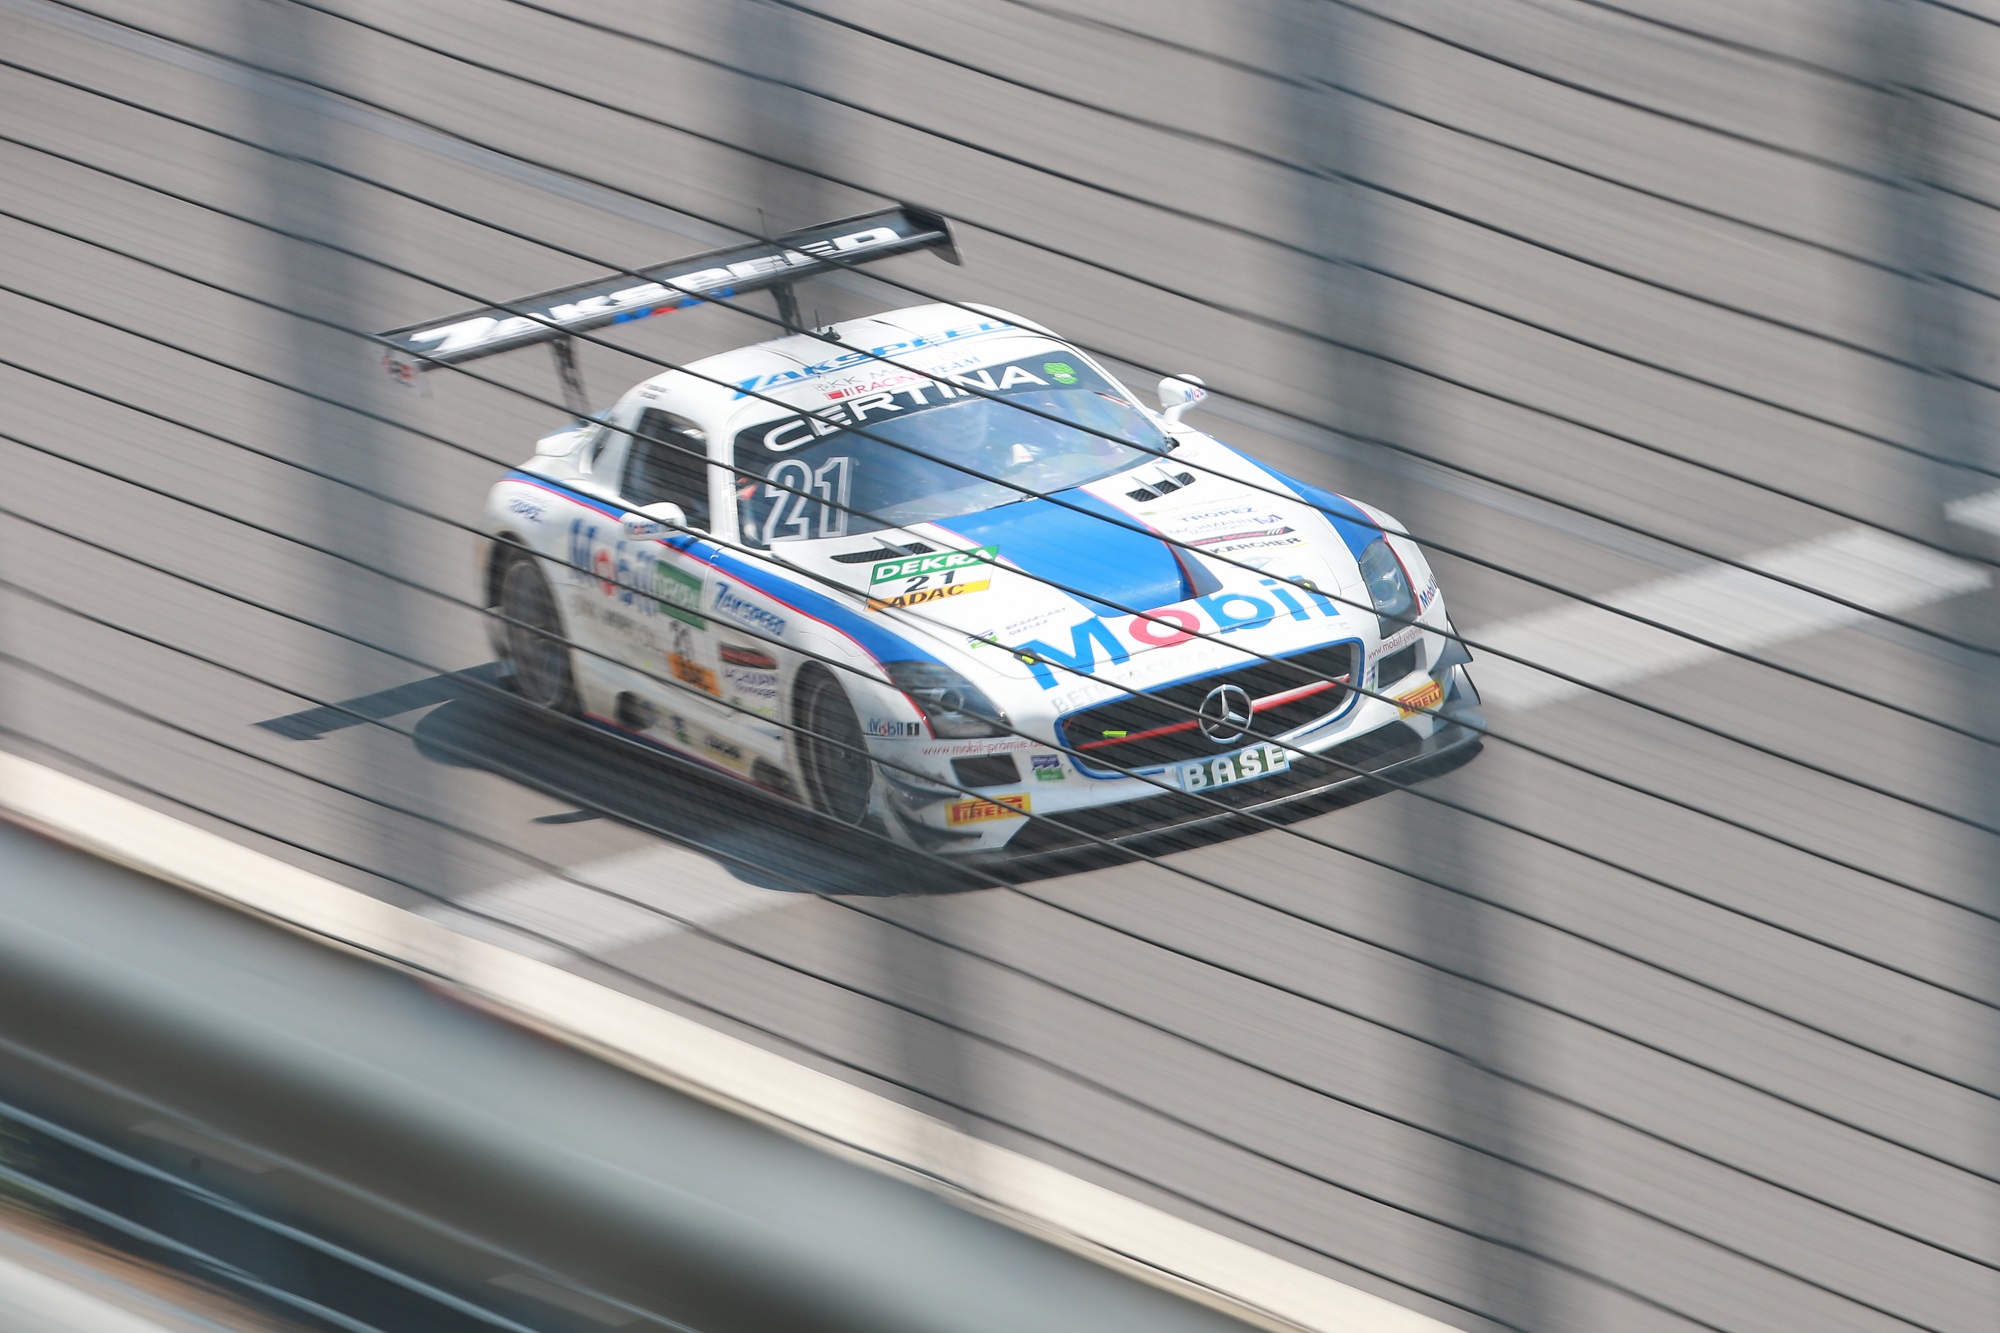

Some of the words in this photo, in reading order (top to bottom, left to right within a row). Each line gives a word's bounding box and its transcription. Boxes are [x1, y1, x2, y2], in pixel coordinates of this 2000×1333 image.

[763, 365, 1050, 452] CERTINA
[762, 457, 853, 546] 21
[876, 549, 993, 581] DEKRA
[904, 570, 956, 594] 21
[888, 584, 965, 609] ADAC
[1011, 575, 1341, 691] Mobil
[869, 718, 904, 736] Mobil
[1181, 744, 1286, 792] BASE
